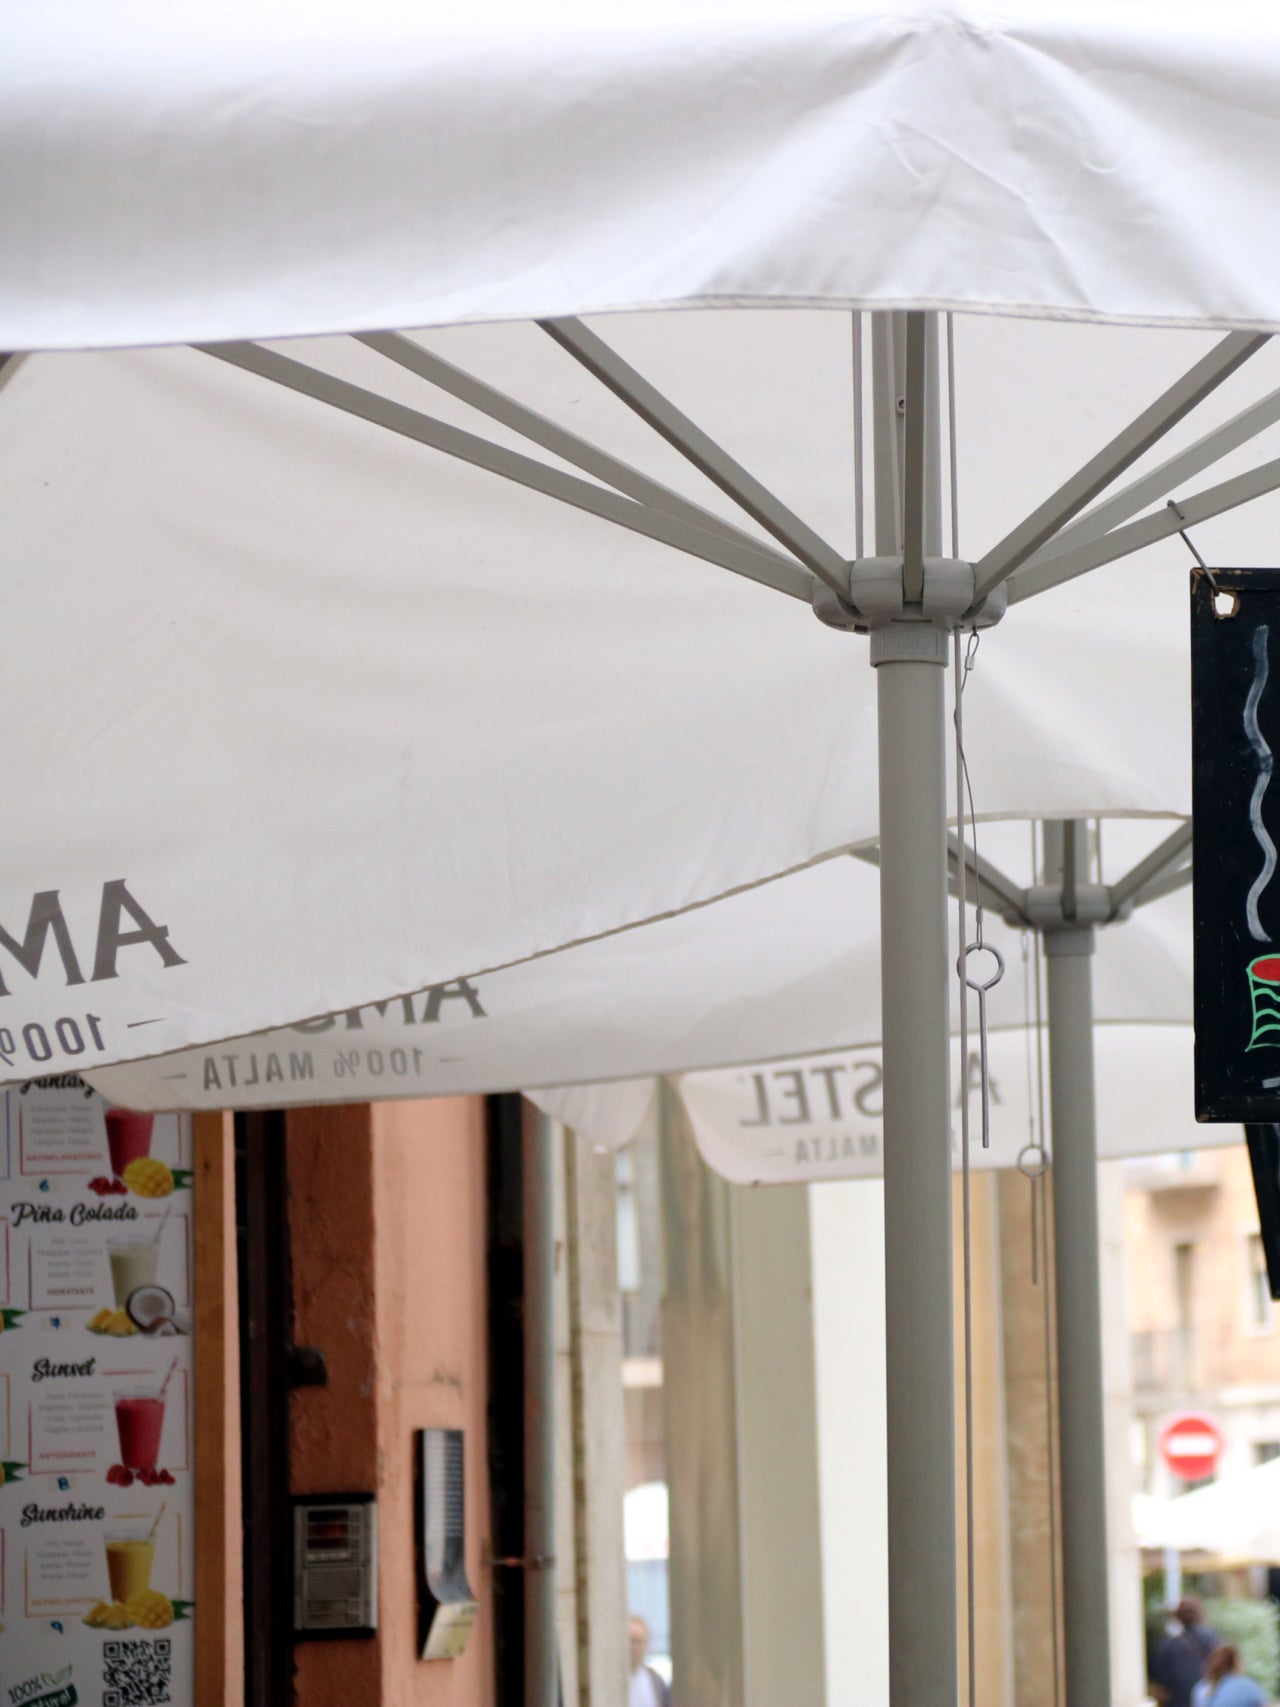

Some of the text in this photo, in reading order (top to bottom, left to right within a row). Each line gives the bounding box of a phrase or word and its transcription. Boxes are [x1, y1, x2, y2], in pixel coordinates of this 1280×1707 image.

[11, 1201, 138, 1228] Piña Colada
[31, 1356, 96, 1383] Sunset
[20, 1501, 106, 1528] Sunshine
